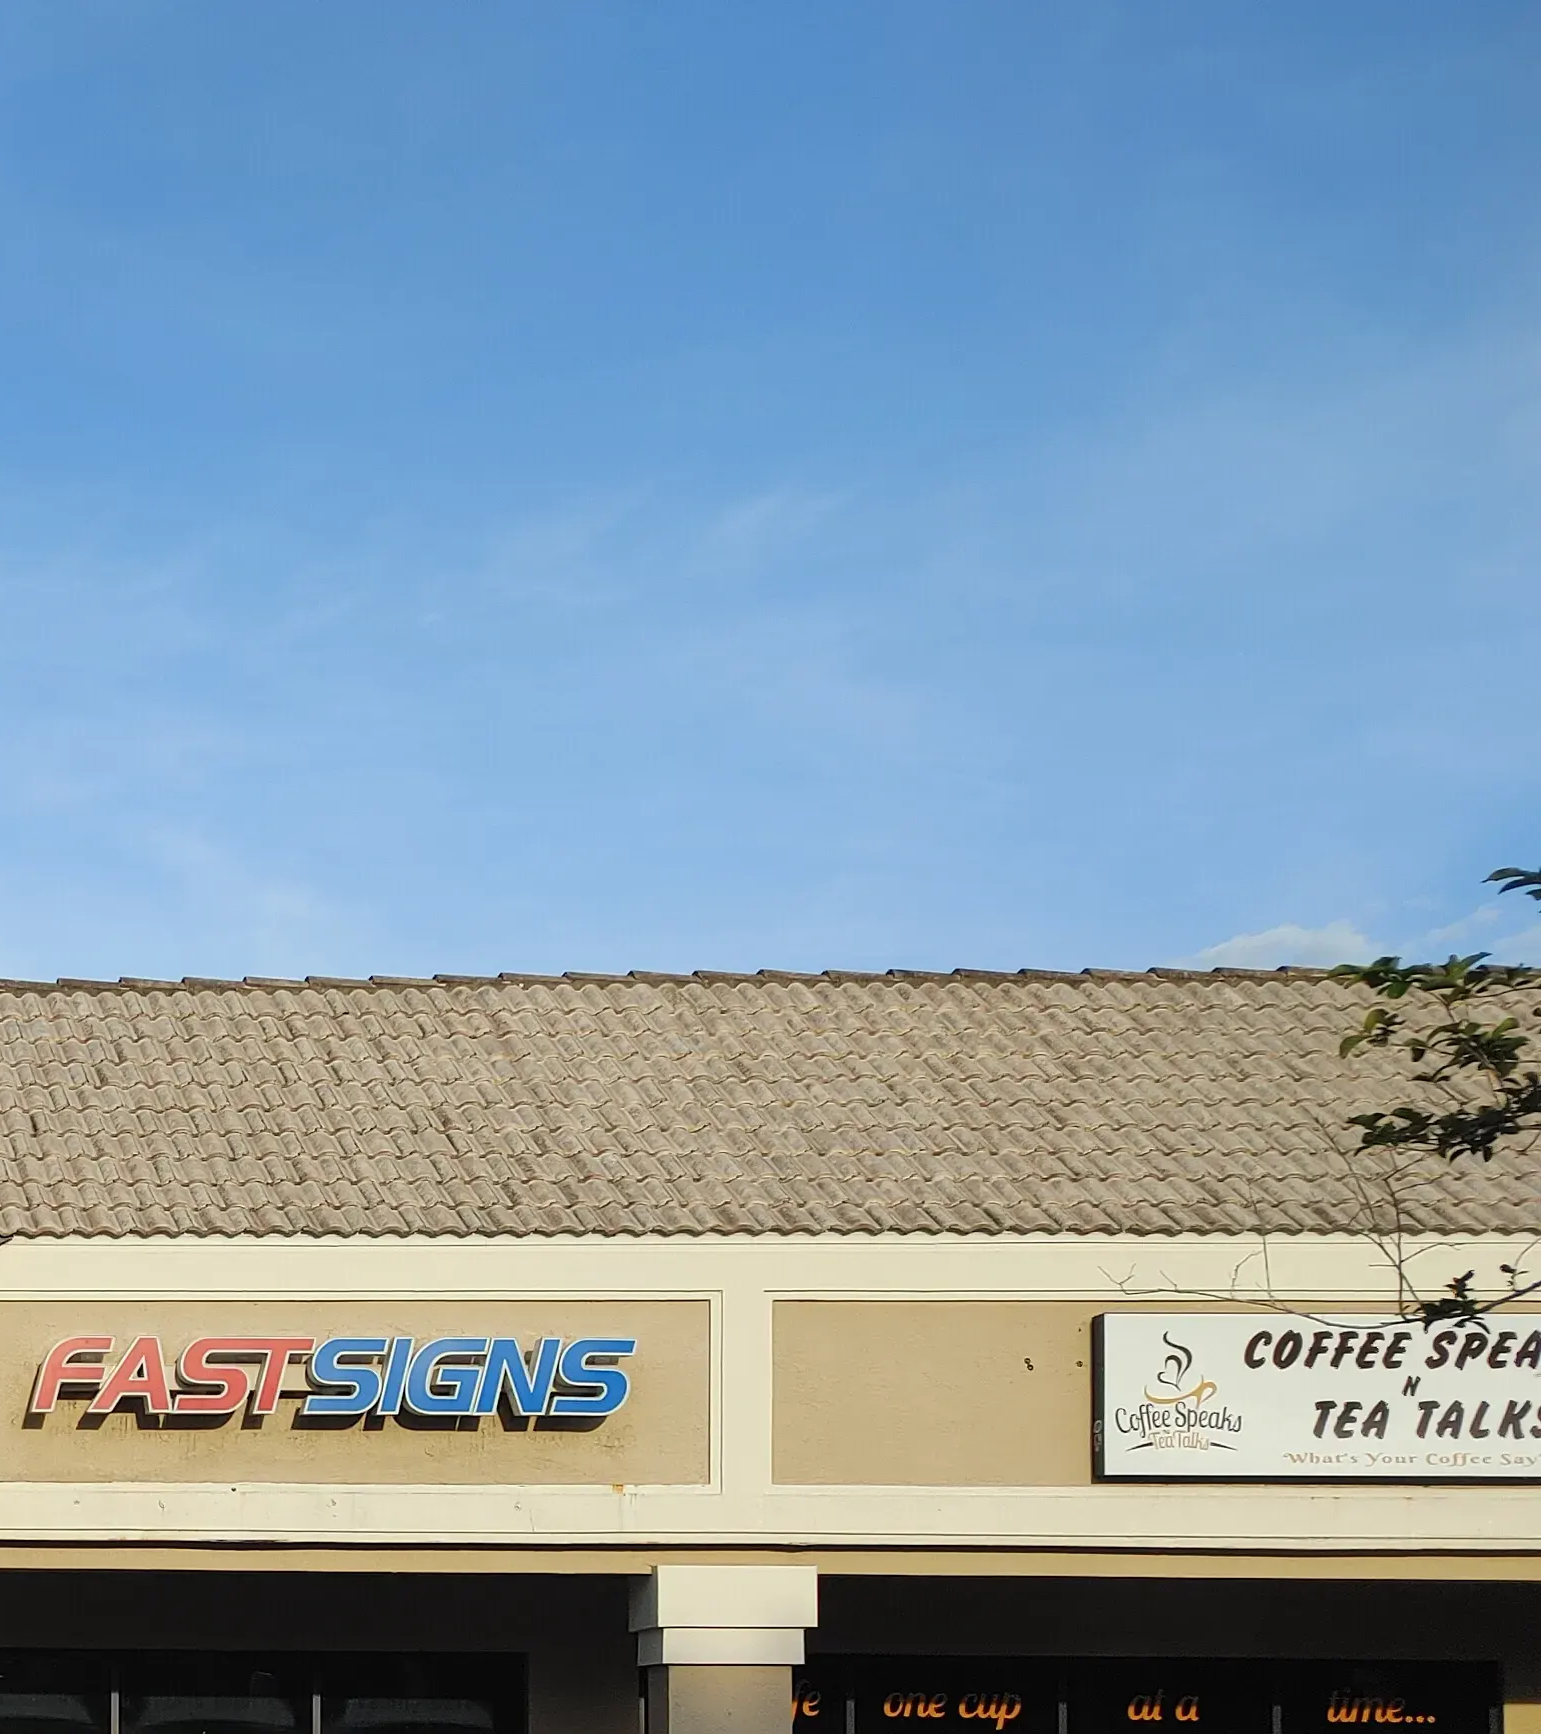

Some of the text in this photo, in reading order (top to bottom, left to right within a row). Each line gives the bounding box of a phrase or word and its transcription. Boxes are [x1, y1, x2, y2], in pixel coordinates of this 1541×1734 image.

[1244, 1330, 1413, 1370] COFFEE
[30, 1336, 637, 1416] FASTSIGNS
[1402, 1376, 1421, 1397] N
[1115, 1403, 1170, 1438] Coffee
[1175, 1401, 1242, 1433] Speaks
[1313, 1400, 1392, 1439] TEA
[1149, 1431, 1210, 1451] Tea Talks
[1365, 1452, 1417, 1467] Your
[1426, 1452, 1492, 1467] Coffee
[883, 1691, 948, 1718] one
[958, 1691, 1021, 1730] cup
[1127, 1689, 1164, 1721] at
[1175, 1695, 1199, 1721] a
